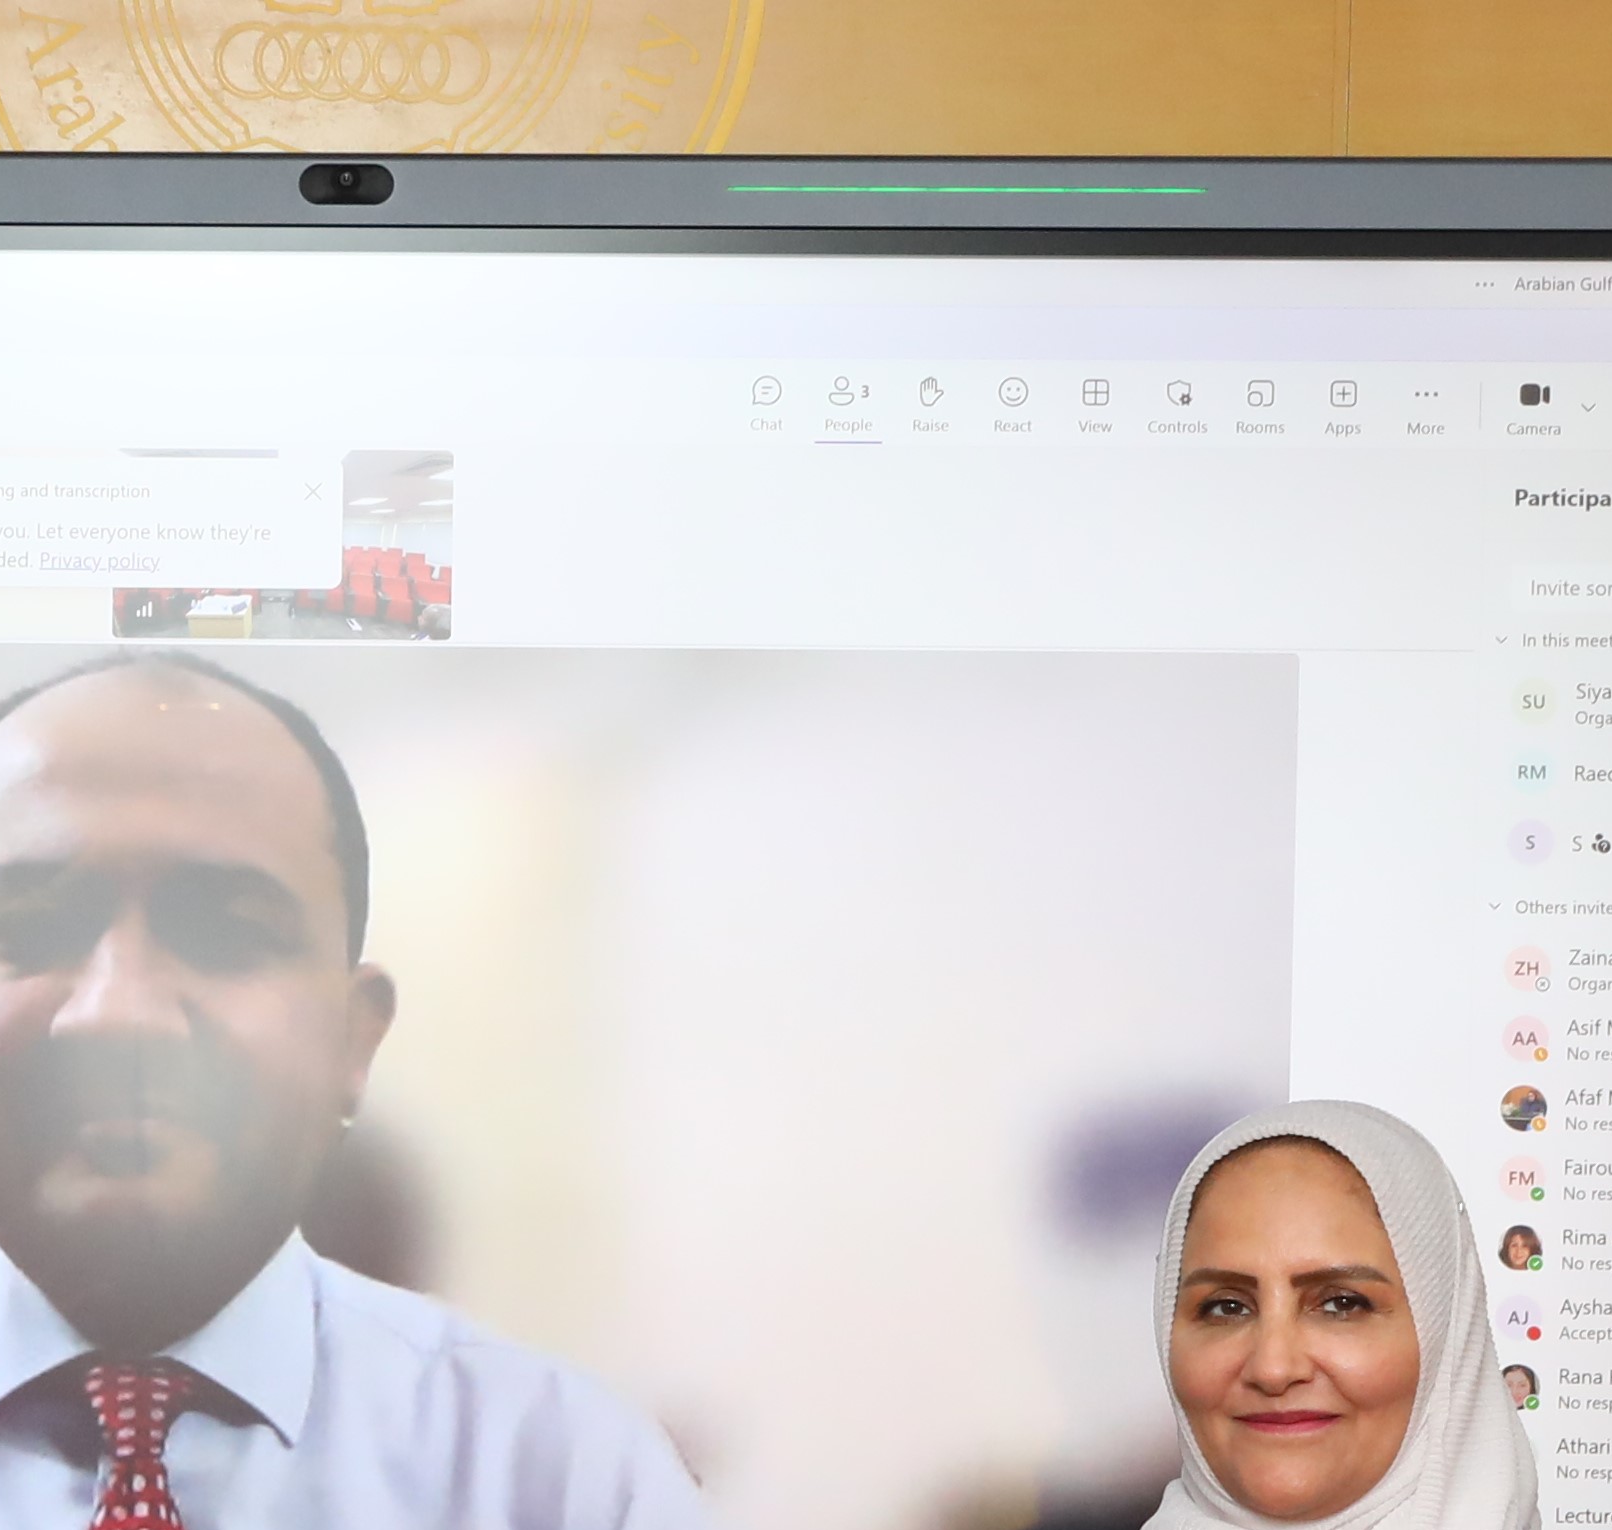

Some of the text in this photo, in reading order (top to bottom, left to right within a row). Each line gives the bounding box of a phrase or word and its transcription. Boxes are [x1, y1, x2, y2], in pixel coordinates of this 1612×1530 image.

[18, 7, 126, 152] Arab
[1514, 277, 1575, 292] Arabian
[1580, 277, 1612, 292] Gulf
[861, 385, 870, 398] 3
[750, 417, 783, 432] Chat
[825, 418, 873, 435] People
[912, 419, 950, 432] Raise
[994, 419, 1032, 433] React
[1078, 420, 1113, 433] View
[1147, 420, 1208, 434] Controls
[1236, 421, 1285, 434] Rooms
[1325, 422, 1362, 437] Apps
[1407, 422, 1445, 435] More
[1506, 423, 1561, 436] Camera
[20, 483, 48, 498] and
[54, 484, 150, 502] transcription
[36, 524, 63, 540] Let
[69, 526, 151, 545] everyone
[157, 524, 204, 541] know
[210, 524, 271, 546] they're
[39, 552, 102, 572] Privacy
[107, 554, 160, 573] policy
[1531, 580, 1580, 597] Invite
[1522, 634, 1538, 648] In
[1542, 634, 1570, 648] this
[1522, 695, 1546, 710] SU
[1518, 766, 1547, 780] RM
[1525, 835, 1536, 850] S
[1572, 836, 1583, 852] S
[1515, 901, 1567, 916] Others
[1514, 961, 1539, 976] ZH
[1567, 1019, 1601, 1036] Asif
[1512, 1031, 1538, 1046] AA
[1566, 1047, 1590, 1061] No
[1565, 1089, 1603, 1106] Afaf
[1565, 1117, 1588, 1131] No
[1508, 1172, 1535, 1186] FM
[1563, 1187, 1587, 1201] No
[1562, 1229, 1607, 1246] Rima
[1561, 1257, 1585, 1271] No
[1560, 1299, 1612, 1319] Aysha
[1507, 1311, 1529, 1325] AJ
[1559, 1369, 1603, 1386] Rana
[1558, 1396, 1581, 1410] No
[1556, 1438, 1611, 1455] Athari
[1556, 1466, 1579, 1480] No
